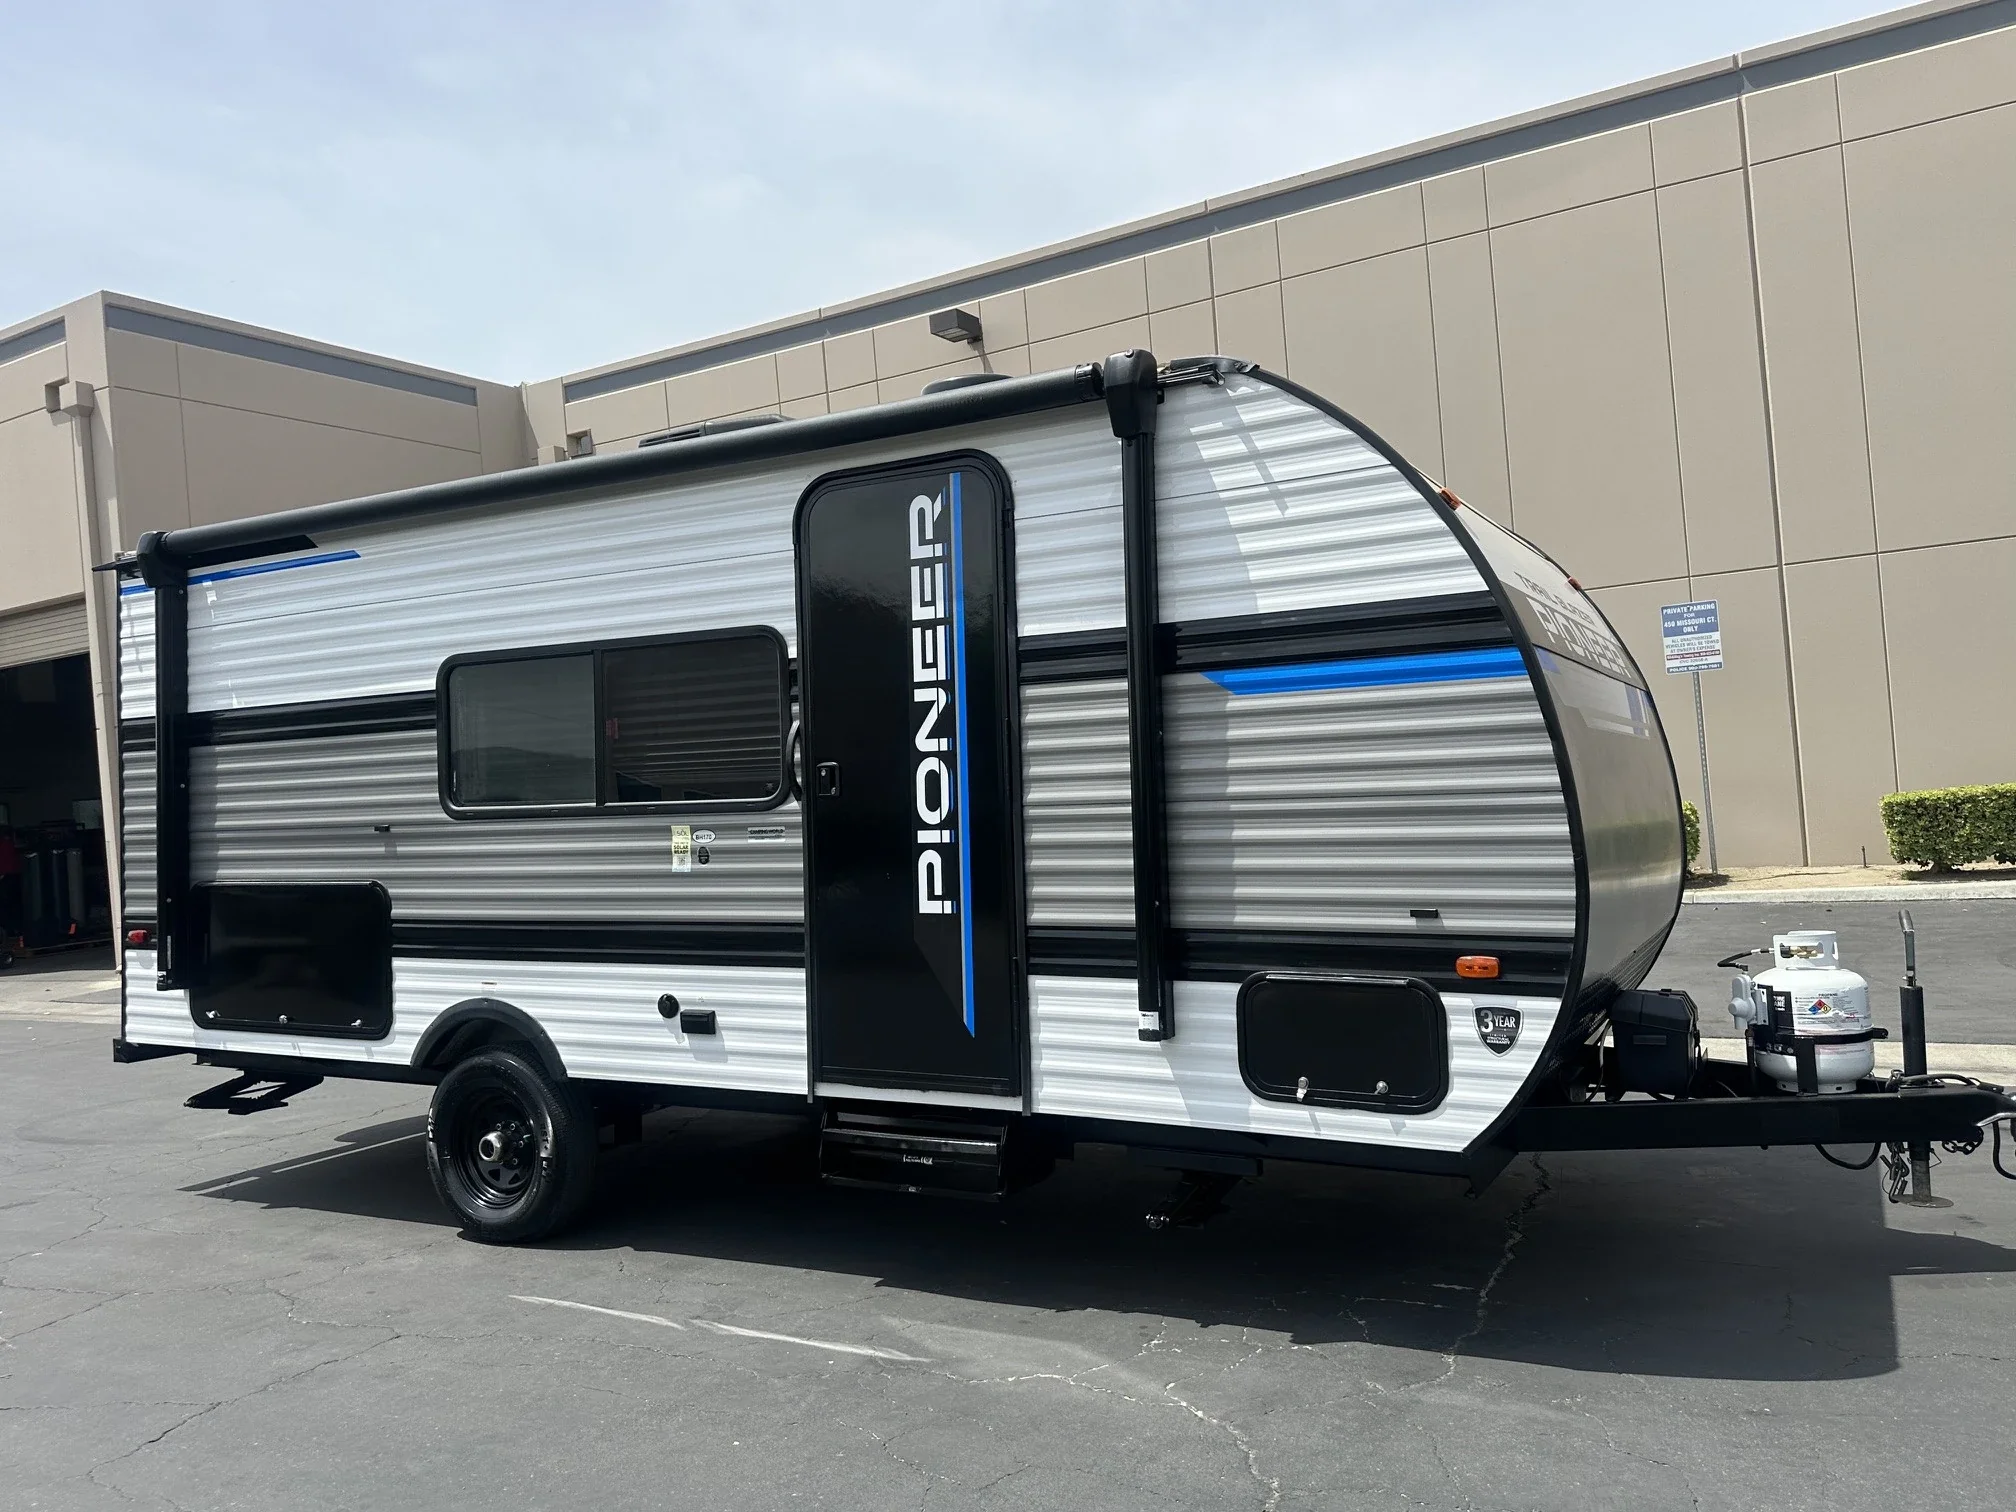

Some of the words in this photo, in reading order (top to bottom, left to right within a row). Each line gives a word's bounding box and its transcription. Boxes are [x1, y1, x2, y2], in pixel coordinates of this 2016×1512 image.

[1663, 607, 1688, 615] PRIVATE
[1690, 603, 1715, 611] PARKING
[1677, 617, 1706, 626] MISSOURI
[1526, 597, 1631, 678] PIONEER
[909, 491, 952, 914] PIONEER
[1480, 1009, 1494, 1033] 3
[1493, 1015, 1516, 1028] YEAR
